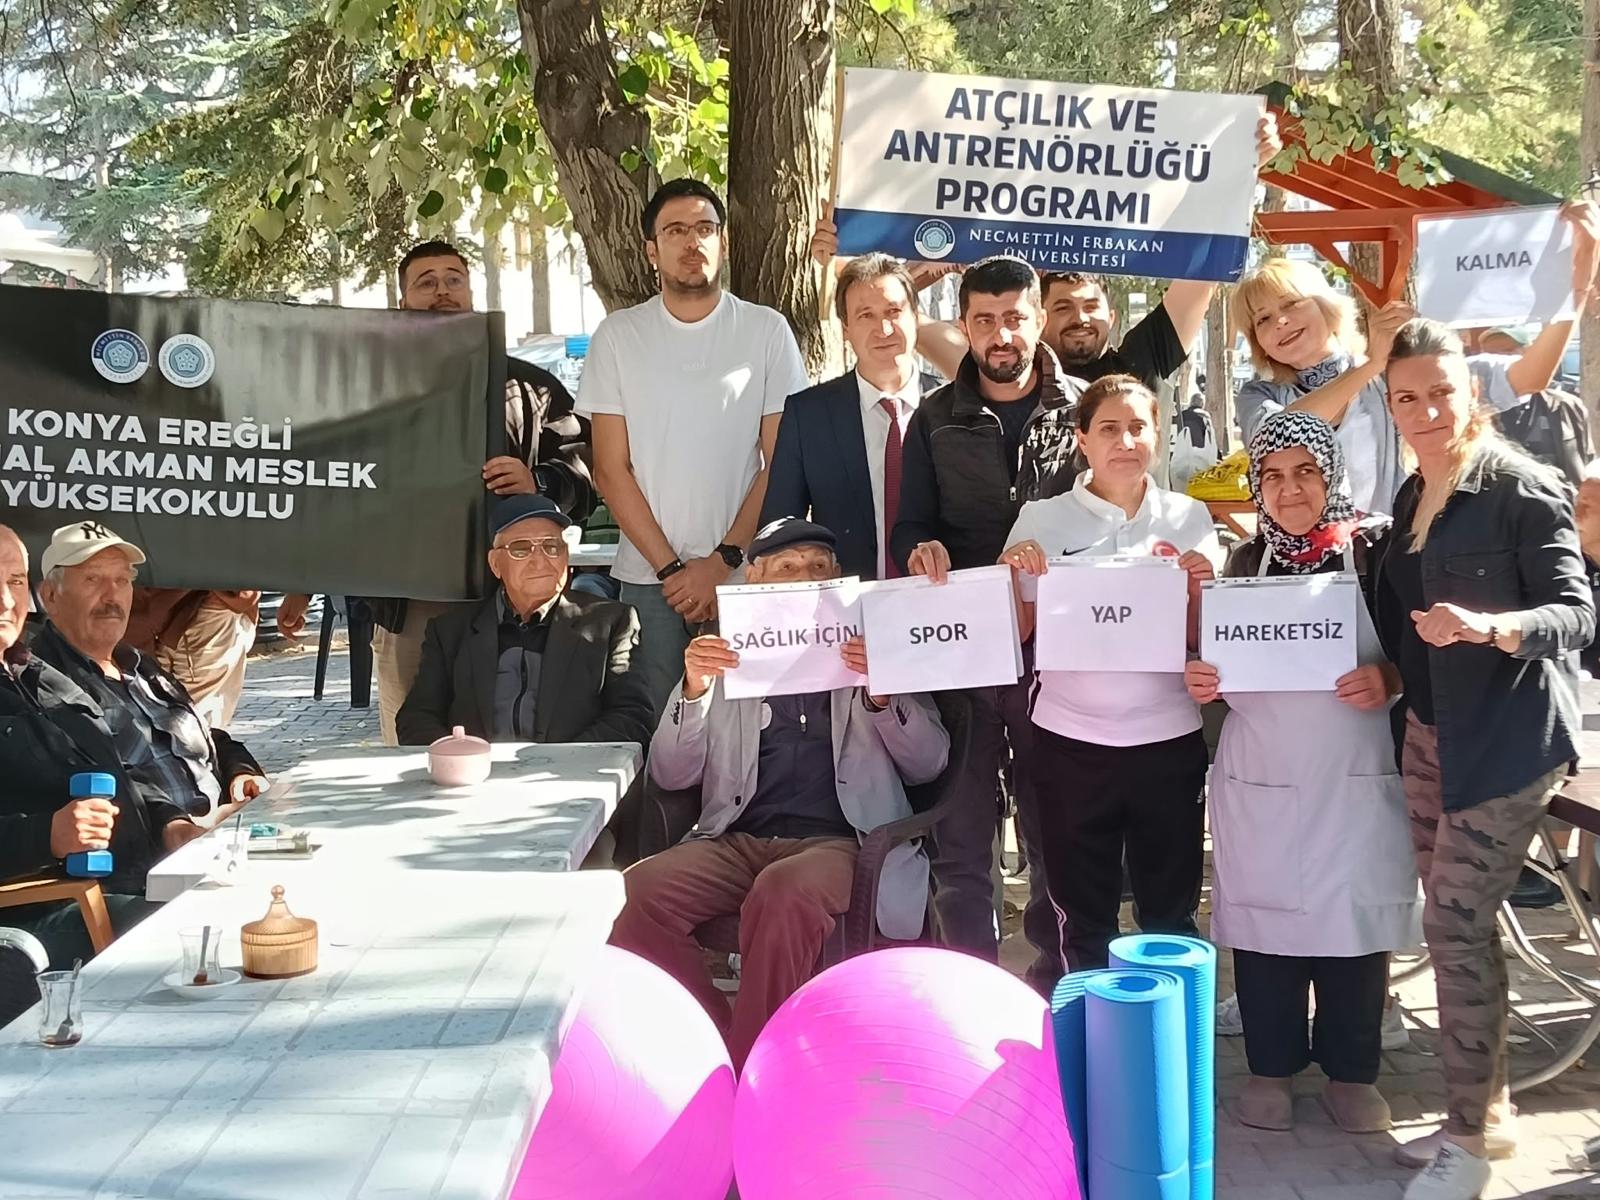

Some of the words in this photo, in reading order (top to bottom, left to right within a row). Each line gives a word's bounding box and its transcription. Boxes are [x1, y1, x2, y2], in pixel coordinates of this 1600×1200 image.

[945, 87, 1093, 130] ATÇILIK
[1108, 99, 1159, 134] VE
[884, 129, 1212, 183] ANTRENÖRLÜĞÜ
[935, 178, 1152, 225] PROGRAMI
[969, 228, 1075, 248] NECMETTİN
[1082, 236, 1165, 254] ERBAKAN
[1456, 250, 1532, 272] KALMA
[8, 408, 147, 443] KONYA
[158, 416, 293, 451] EREĞLİ
[0, 443, 55, 473] AL
[65, 447, 213, 482] AKMAN
[225, 456, 378, 489] MESLEK
[0, 471, 295, 520] YÜKSEKOKULU
[80, 521, 111, 540] NY
[1090, 605, 1132, 624] YAP
[1215, 618, 1344, 641] HAREKETSİZ
[732, 626, 810, 651] SAĞLIK
[815, 621, 859, 648] İÇİN
[909, 622, 968, 645] SPOR
